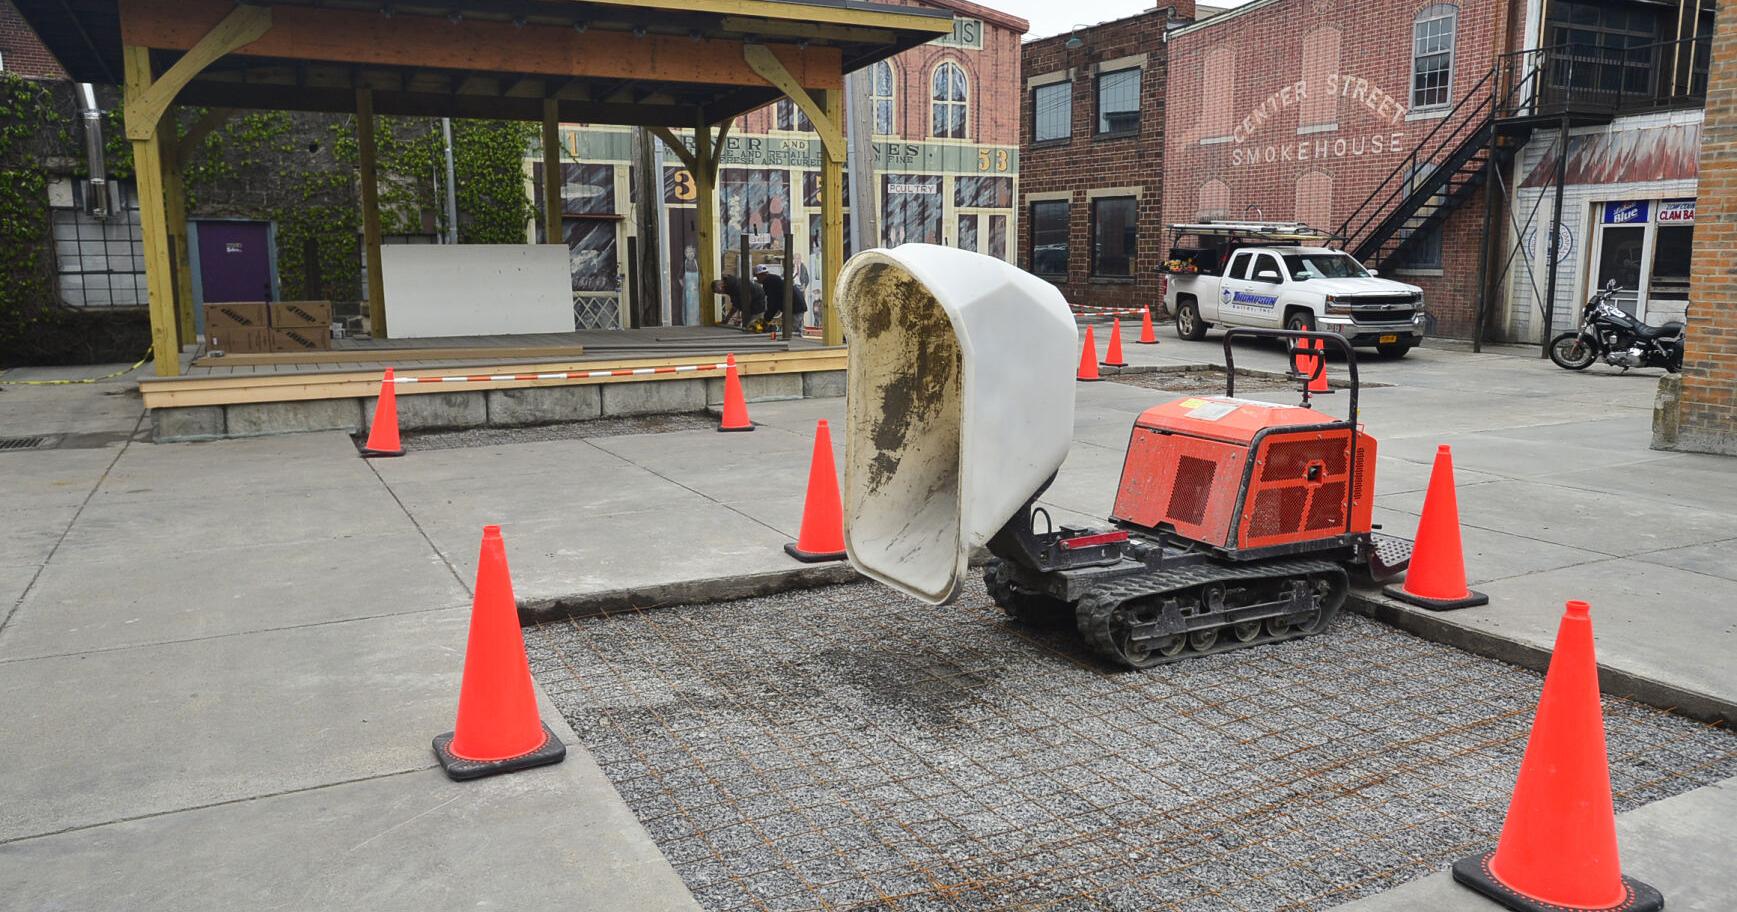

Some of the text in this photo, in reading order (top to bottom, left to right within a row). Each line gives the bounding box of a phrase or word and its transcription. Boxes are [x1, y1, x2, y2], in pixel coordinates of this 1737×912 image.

[1233, 74, 1408, 143] CENTER STREET
[782, 140, 806, 149] AND
[1232, 132, 1404, 166] SMOKEHOUSE
[741, 150, 762, 159] AND
[768, 151, 809, 159] RETAIL
[887, 156, 914, 164] FINE
[978, 148, 1009, 172] 53
[889, 184, 934, 193] POULTRY
[1613, 208, 1639, 223] Blue
[1659, 210, 1682, 221] CLAM
